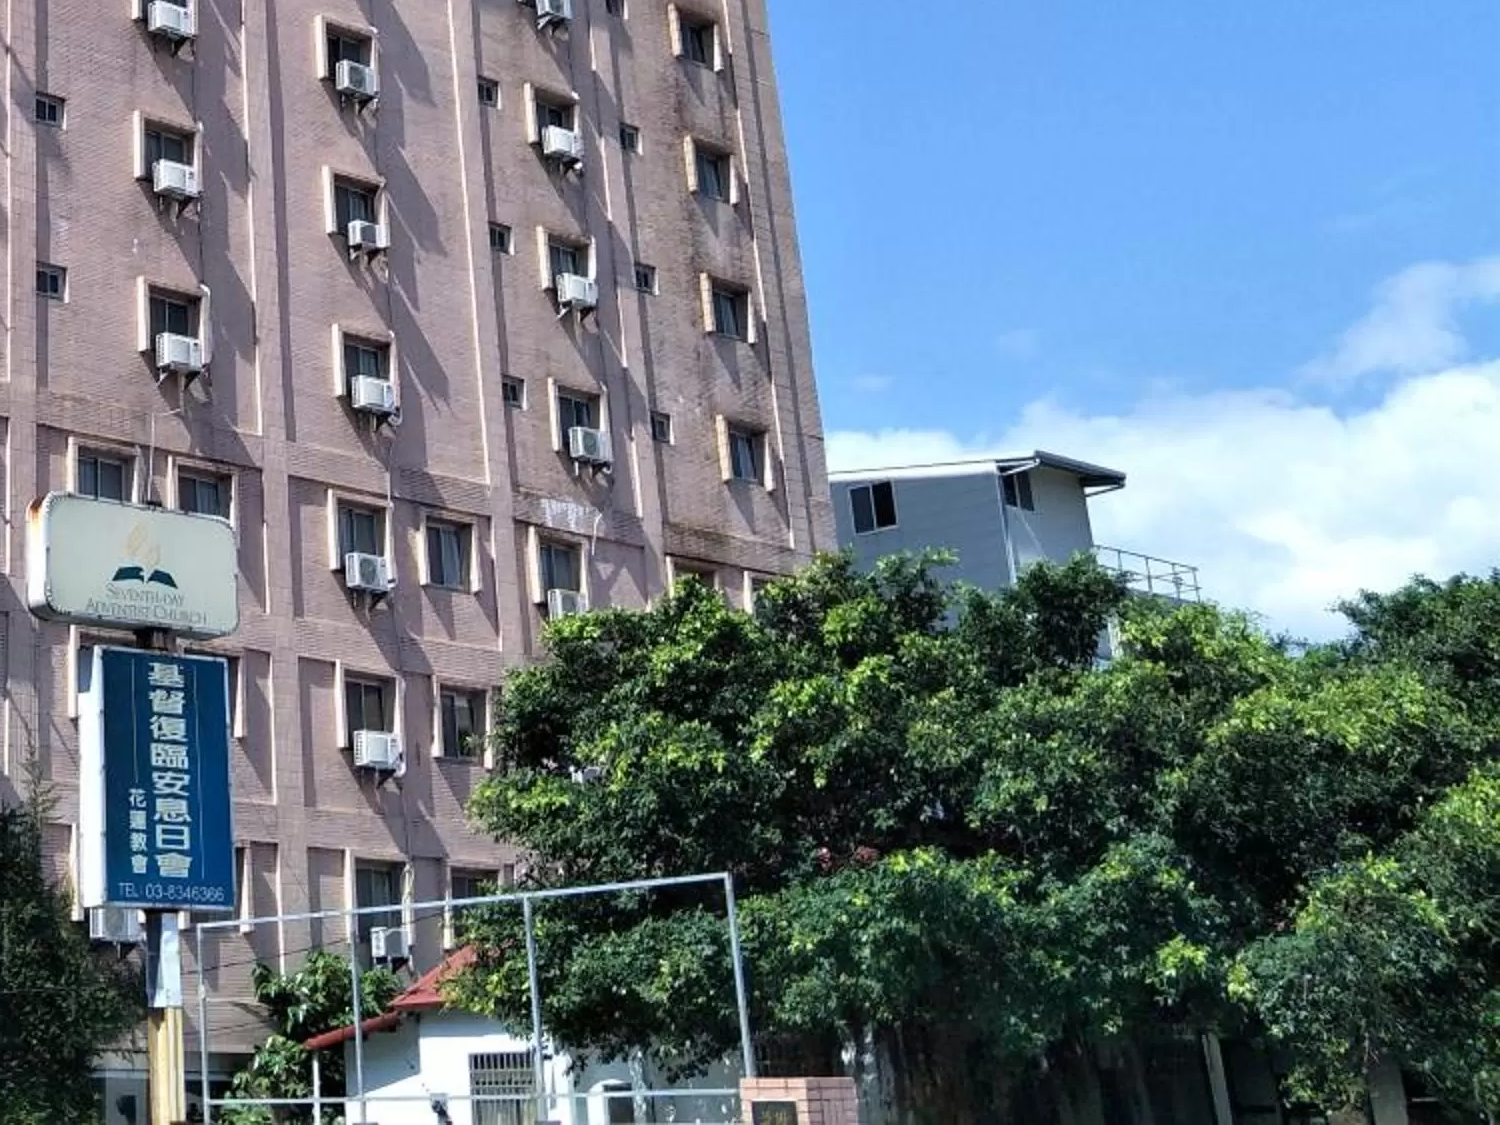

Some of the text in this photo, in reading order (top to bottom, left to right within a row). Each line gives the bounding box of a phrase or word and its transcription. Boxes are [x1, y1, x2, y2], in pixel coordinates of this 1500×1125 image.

[147, 661, 194, 878] 基督復臨安息日會
